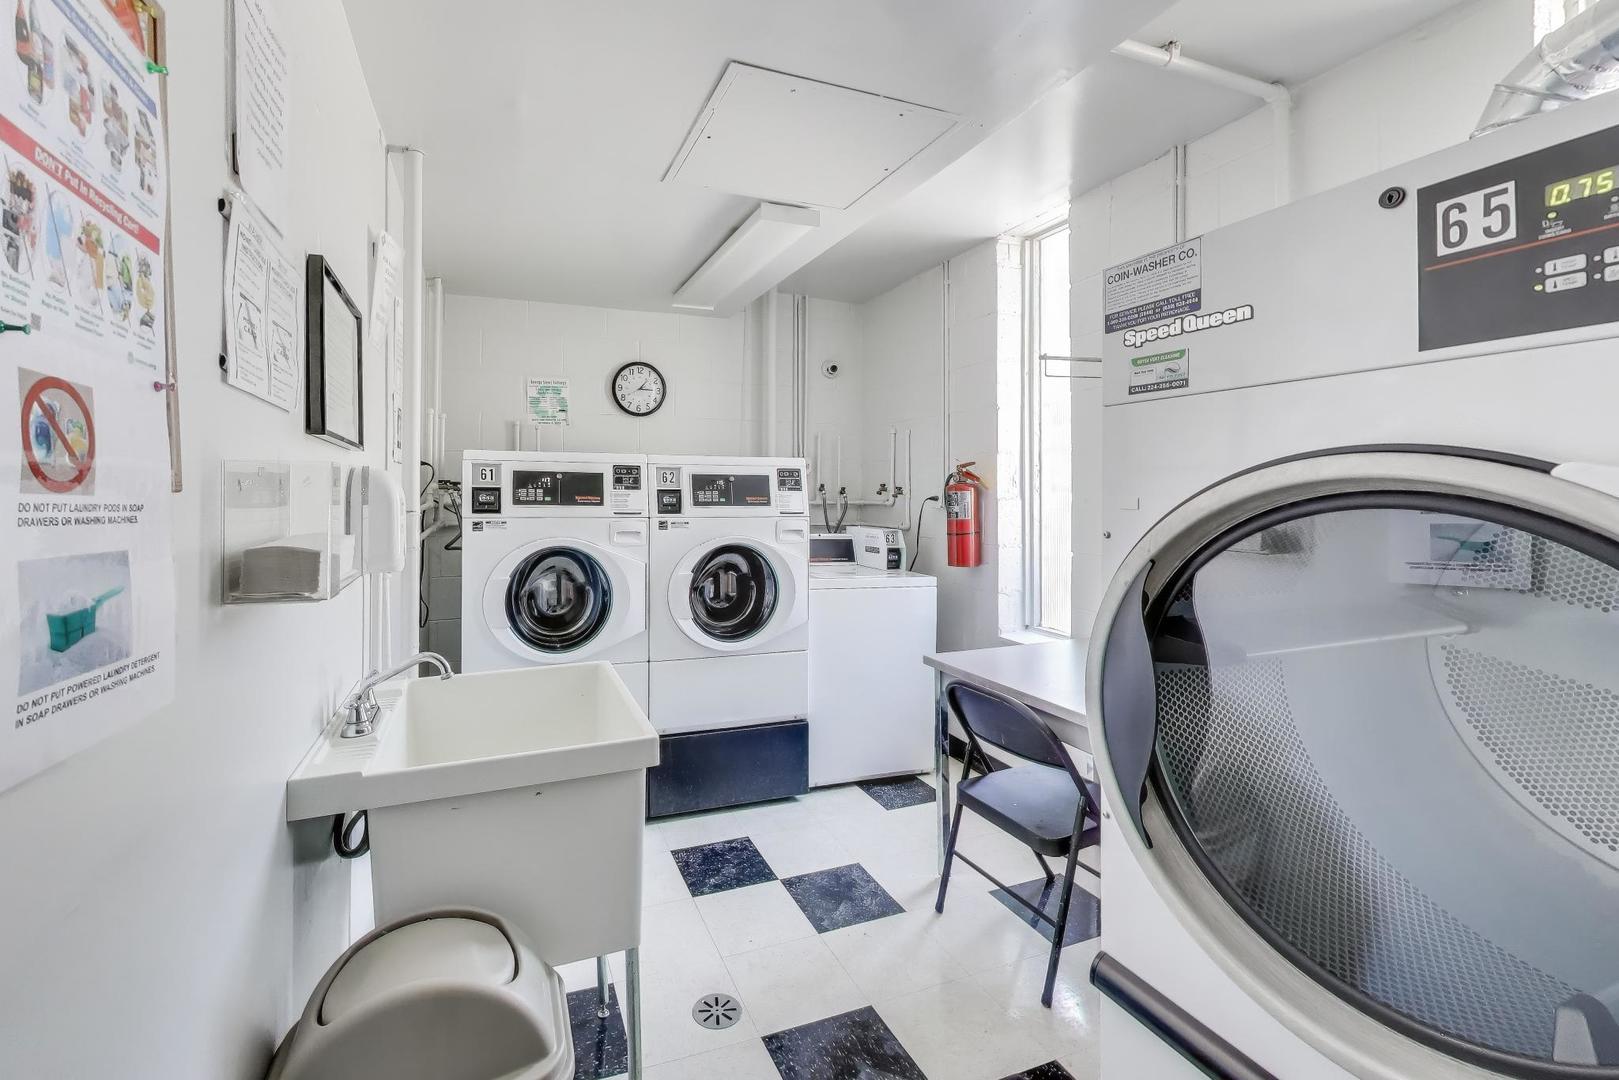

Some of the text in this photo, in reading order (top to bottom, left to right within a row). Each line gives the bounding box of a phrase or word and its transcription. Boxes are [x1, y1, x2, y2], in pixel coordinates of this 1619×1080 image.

[1549, 171, 1614, 206] 0.75
[1441, 187, 1512, 248] 65
[1107, 247, 1198, 285] COIN-WASHER CO.
[1123, 304, 1254, 349] Speed Queen
[629, 368, 635, 376] 11
[637, 366, 645, 375] 12
[620, 373, 629, 382] 10
[653, 377, 659, 385] 2
[617, 383, 623, 392] 9
[656, 387, 662, 395] 3
[620, 393, 626, 402] 8
[652, 397, 658, 405] 4
[627, 401, 633, 409] 7
[636, 404, 642, 412] 6
[646, 402, 651, 411] 5
[480, 468, 494, 481] 61
[662, 471, 675, 484] 62
[17, 502, 145, 513] DO NOT PUT LAUNDRY PODS IN SOAP
[17, 515, 138, 527] DRAWERS OR WASHING MACHINES
[885, 533, 895, 544] 63
[16, 651, 161, 714] DO NOT PUT POWERED LAUNDRY DETERGENT
[15, 664, 156, 729] IN SOAP DRAWERS OR WASHING MACHINES
